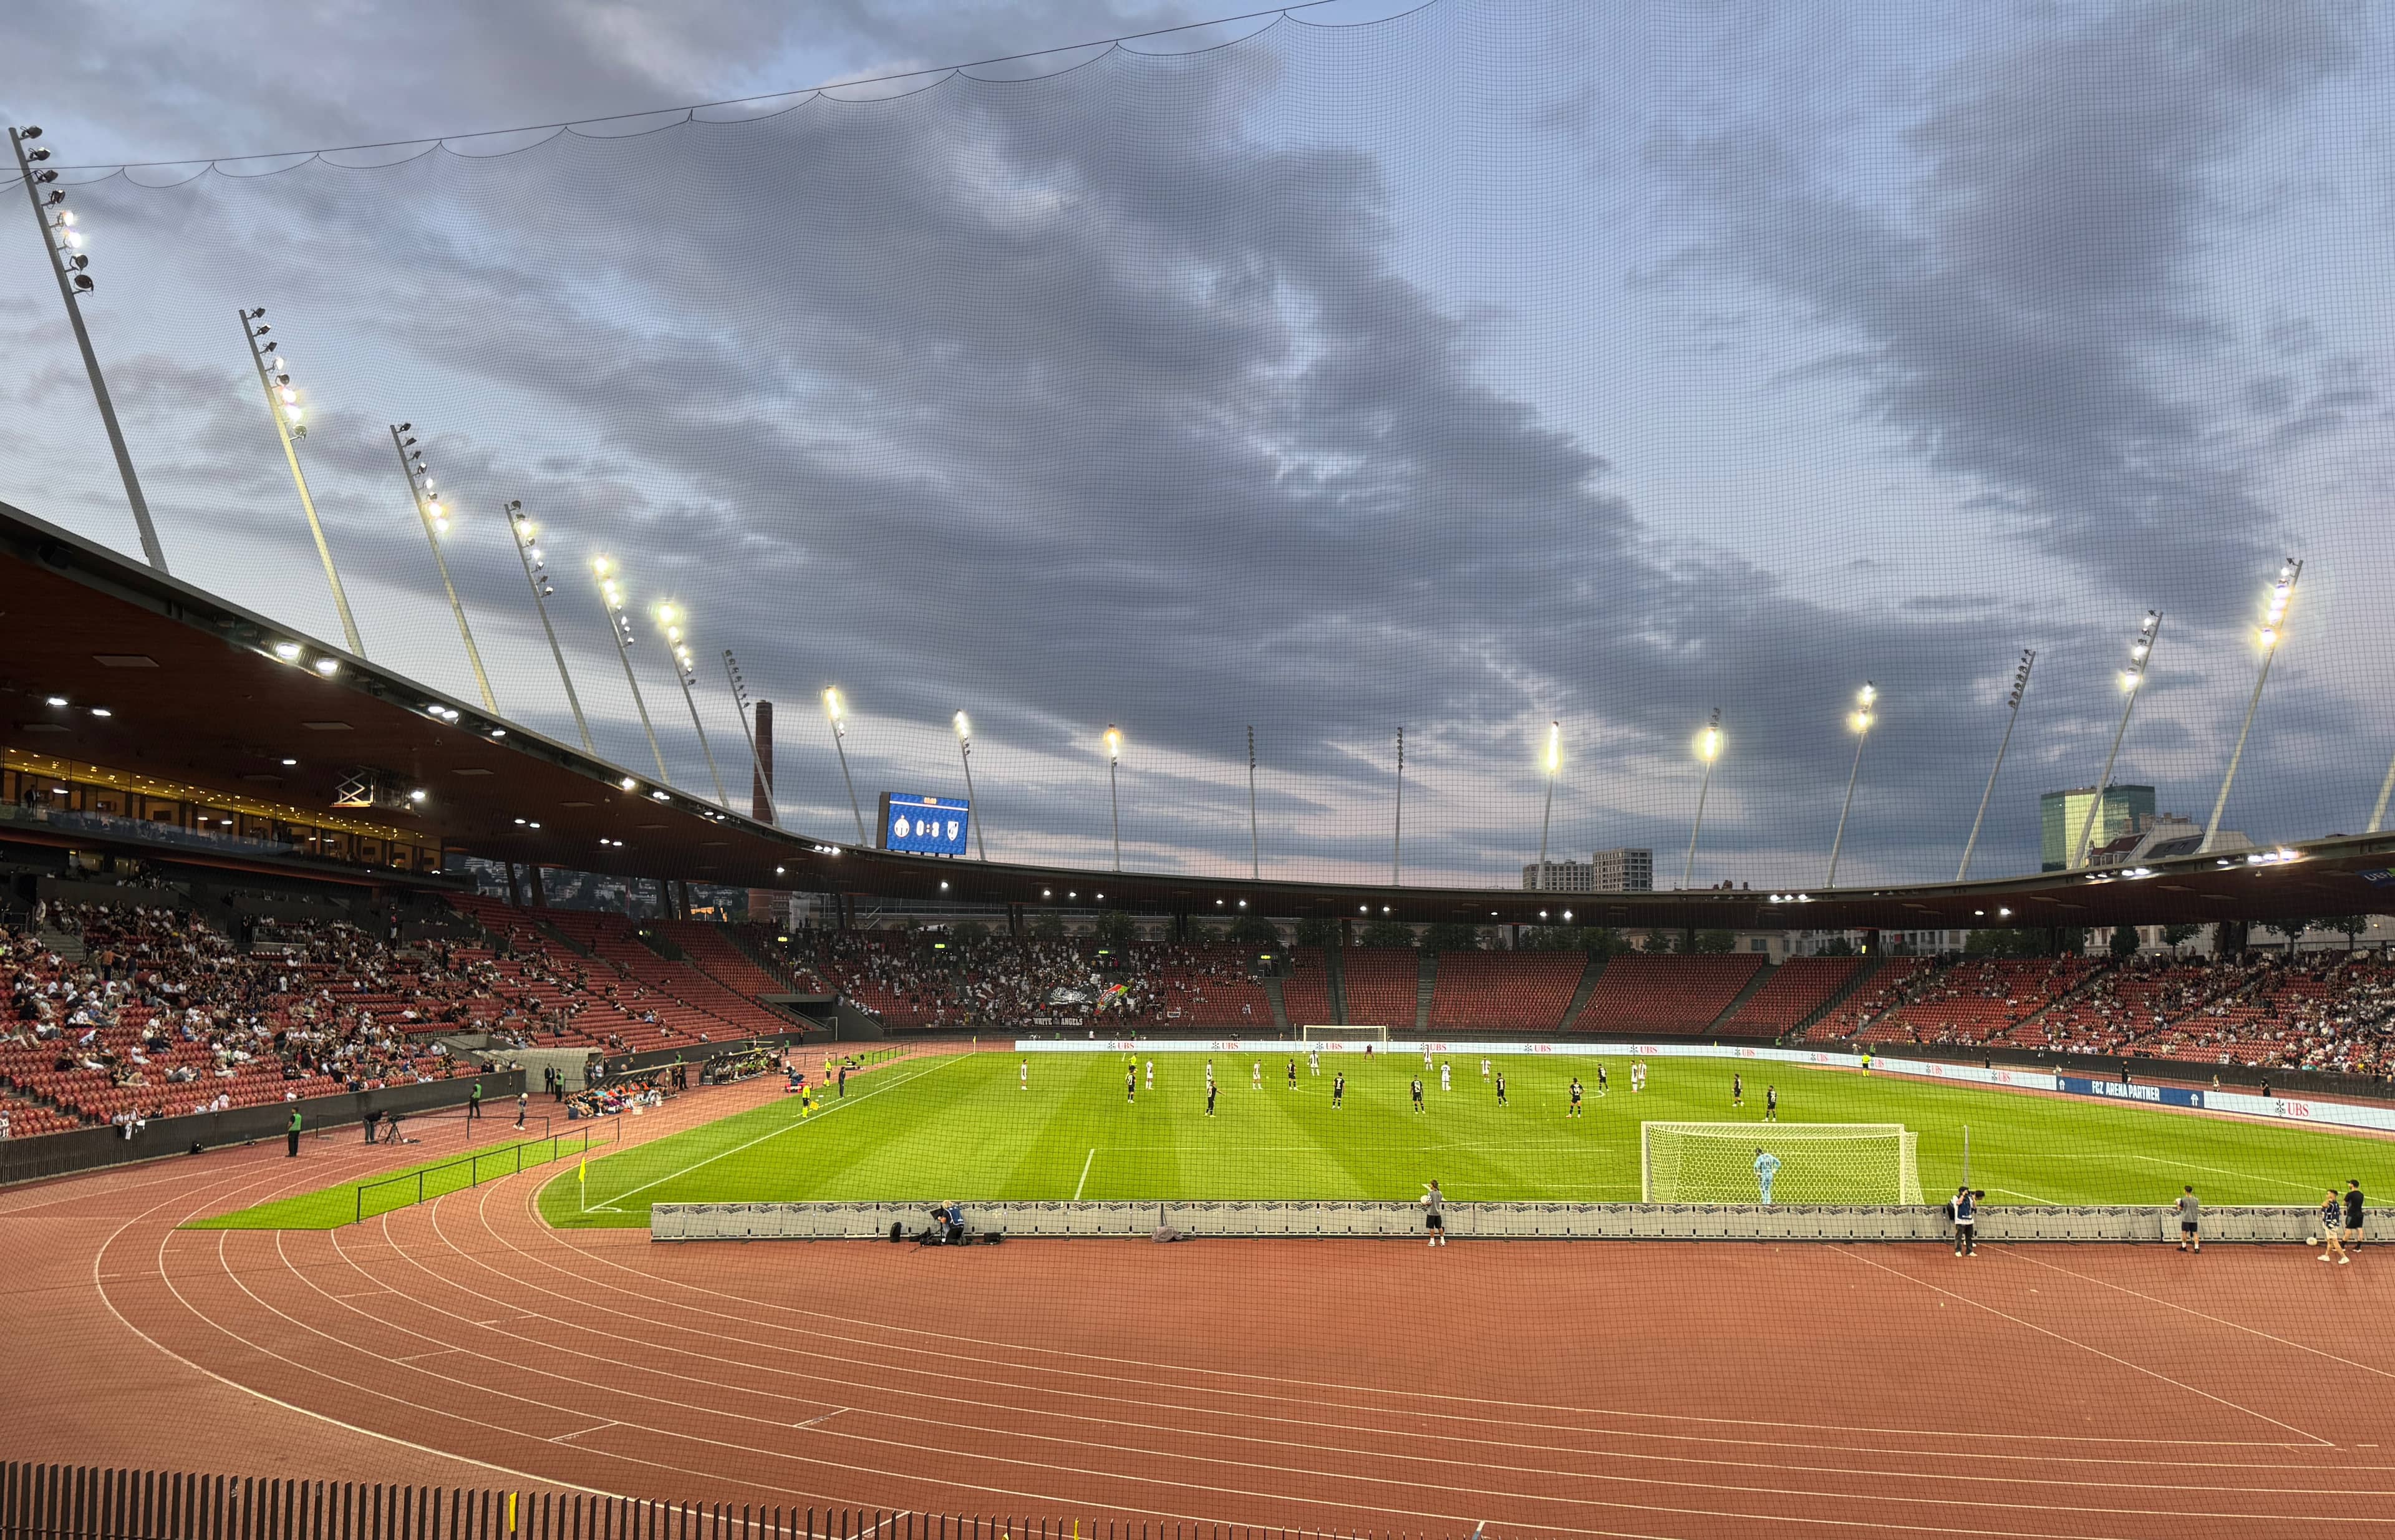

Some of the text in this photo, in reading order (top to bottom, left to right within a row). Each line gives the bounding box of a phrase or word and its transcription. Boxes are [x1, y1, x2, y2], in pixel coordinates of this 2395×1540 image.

[1033, 1017, 1083, 1025] WHITE ANGELS
[1118, 1042, 1135, 1050] UBS
[1742, 1048, 1755, 1057] UBS
[1816, 1053, 1828, 1062] UBS
[1875, 1059, 1884, 1068] UBS
[1931, 1065, 1942, 1075] UBS
[1998, 1072, 2011, 1082] UBS
[2092, 1081, 2160, 1101] FCZ ARENA PARTNER
[2288, 1103, 2309, 1116] UBS
